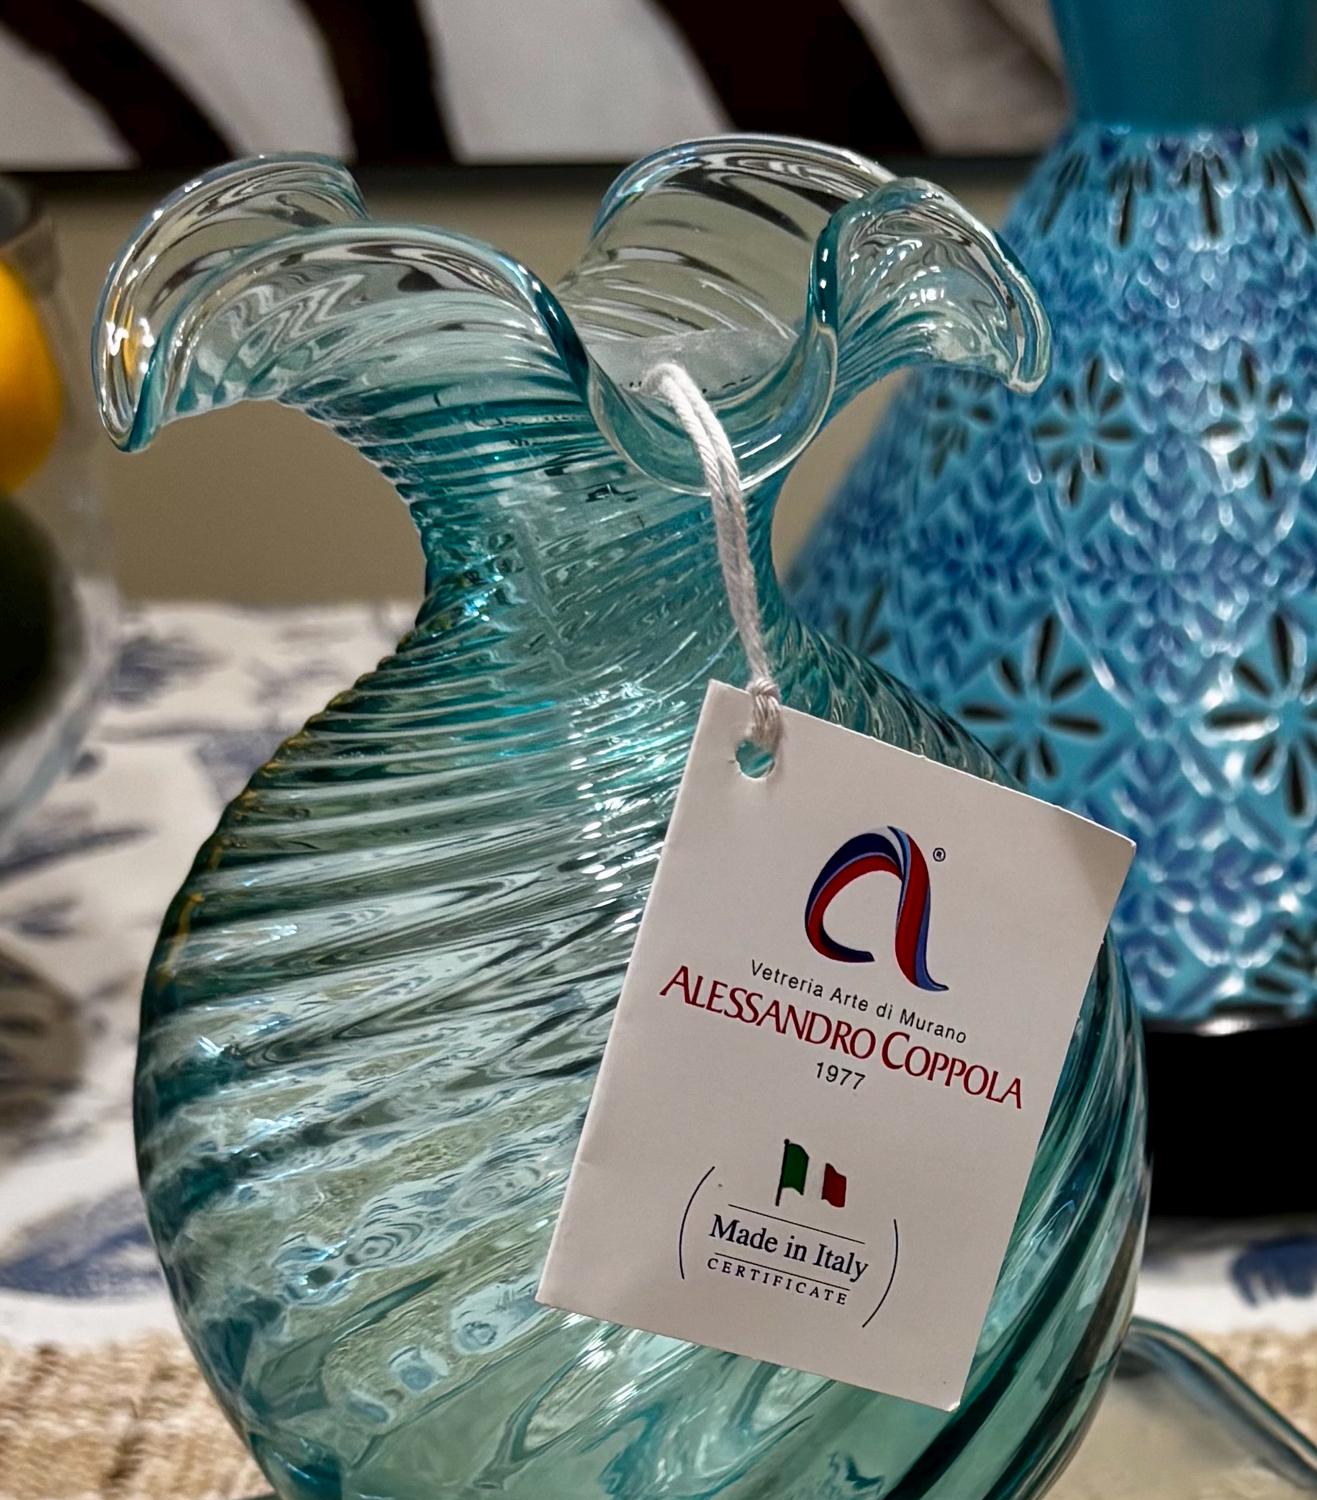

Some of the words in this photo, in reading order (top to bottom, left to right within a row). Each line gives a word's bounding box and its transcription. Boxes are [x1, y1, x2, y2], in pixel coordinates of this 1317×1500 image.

[751, 959, 824, 998] Vetreria
[829, 987, 869, 1012] Arte
[876, 1001, 894, 1020] di
[900, 1009, 967, 1044] Murano
[659, 965, 876, 1060] ALESSANDRO
[881, 1031, 1022, 1110] COPPOLA
[815, 1061, 866, 1091] 1977
[706, 1257, 848, 1306] CERTIFICATE
[708, 1214, 778, 1253] Made
[783, 1235, 807, 1262] in
[812, 1243, 869, 1283] Italy
